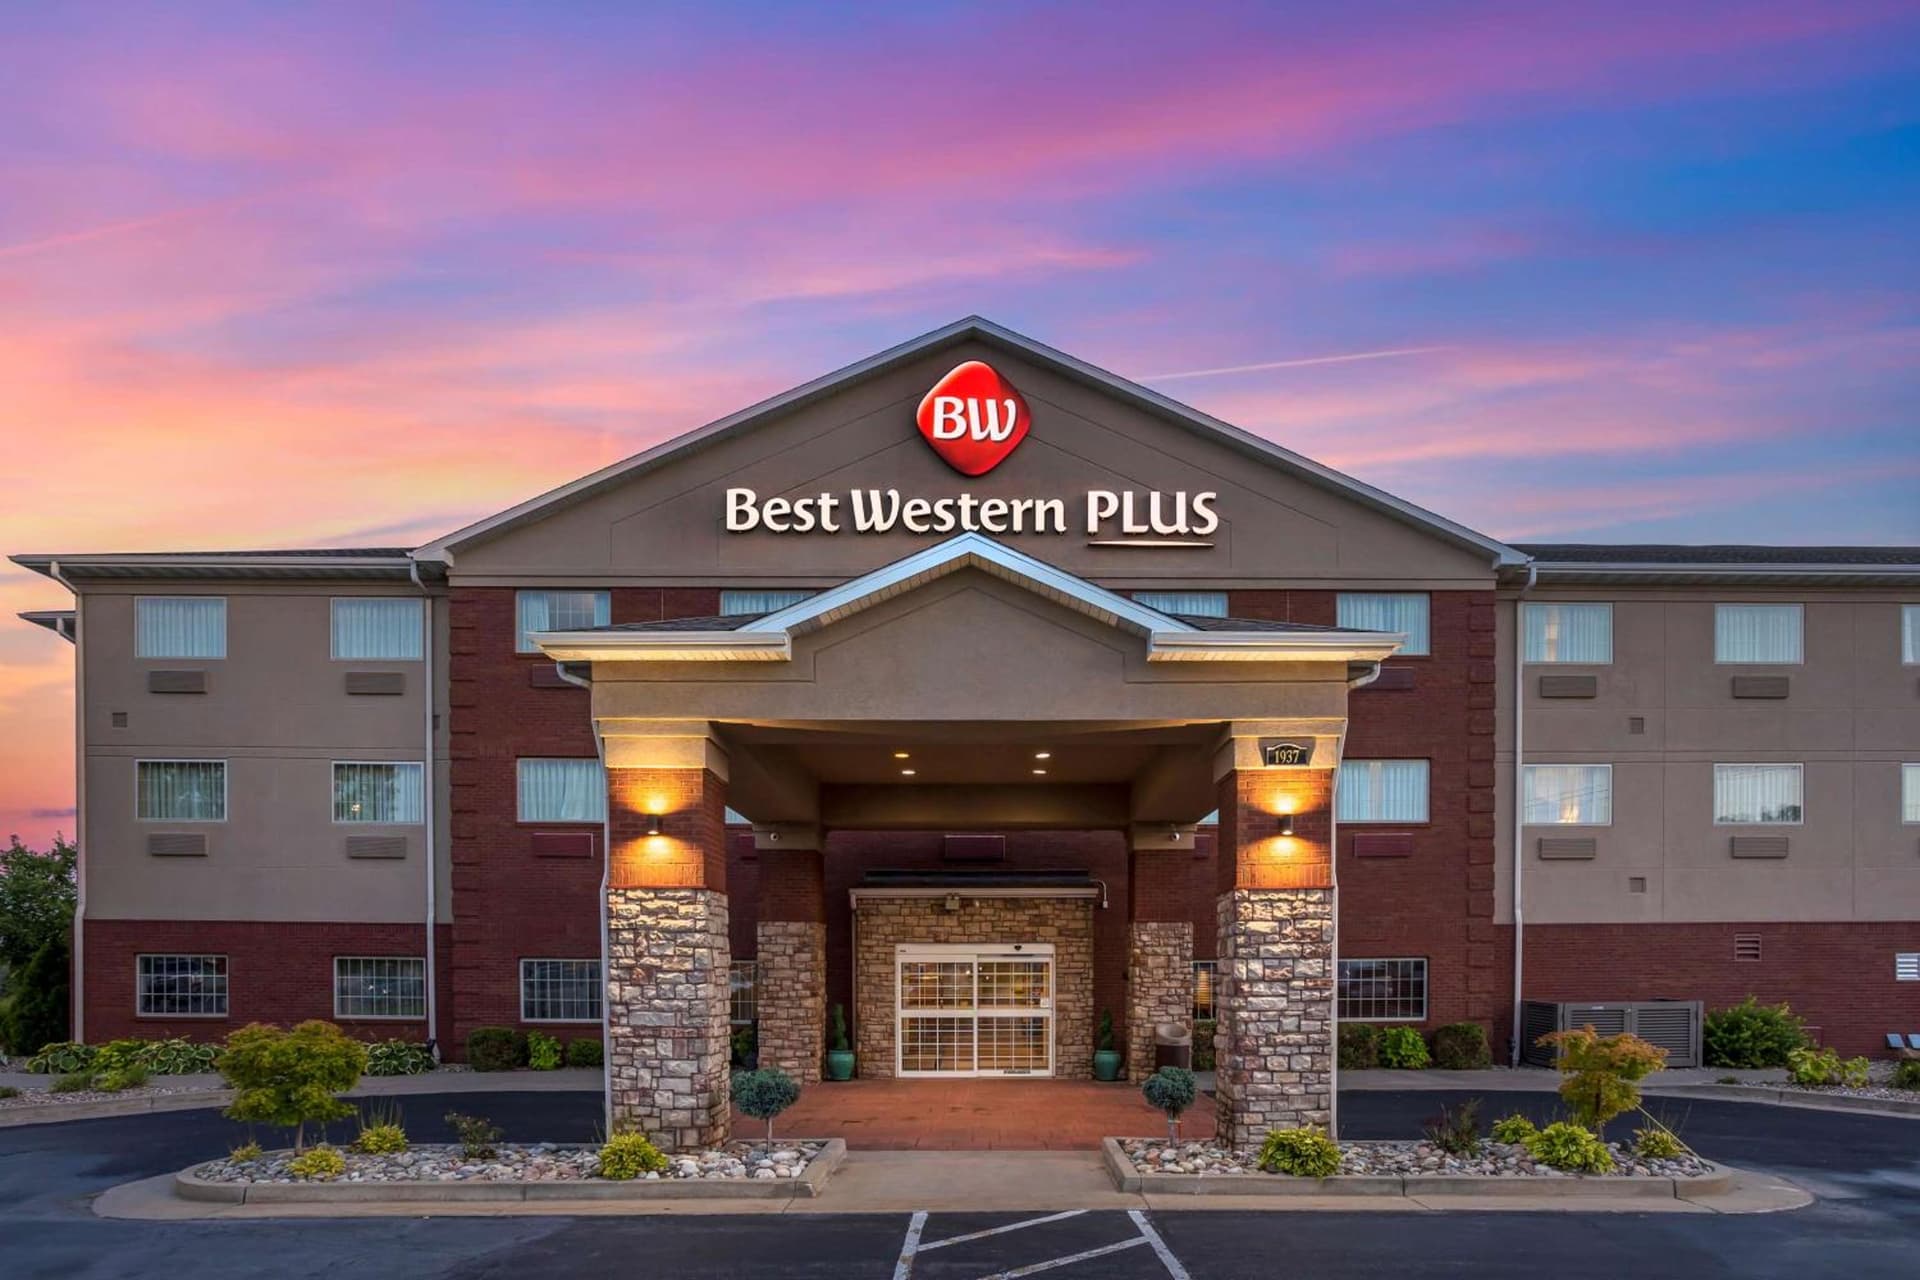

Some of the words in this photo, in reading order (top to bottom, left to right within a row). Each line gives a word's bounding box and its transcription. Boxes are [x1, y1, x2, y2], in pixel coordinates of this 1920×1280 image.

[932, 396, 1017, 441] BW
[726, 488, 840, 532] Best
[851, 489, 1066, 533] Western
[1087, 490, 1219, 535] PLUS
[1275, 750, 1299, 764] 1937
